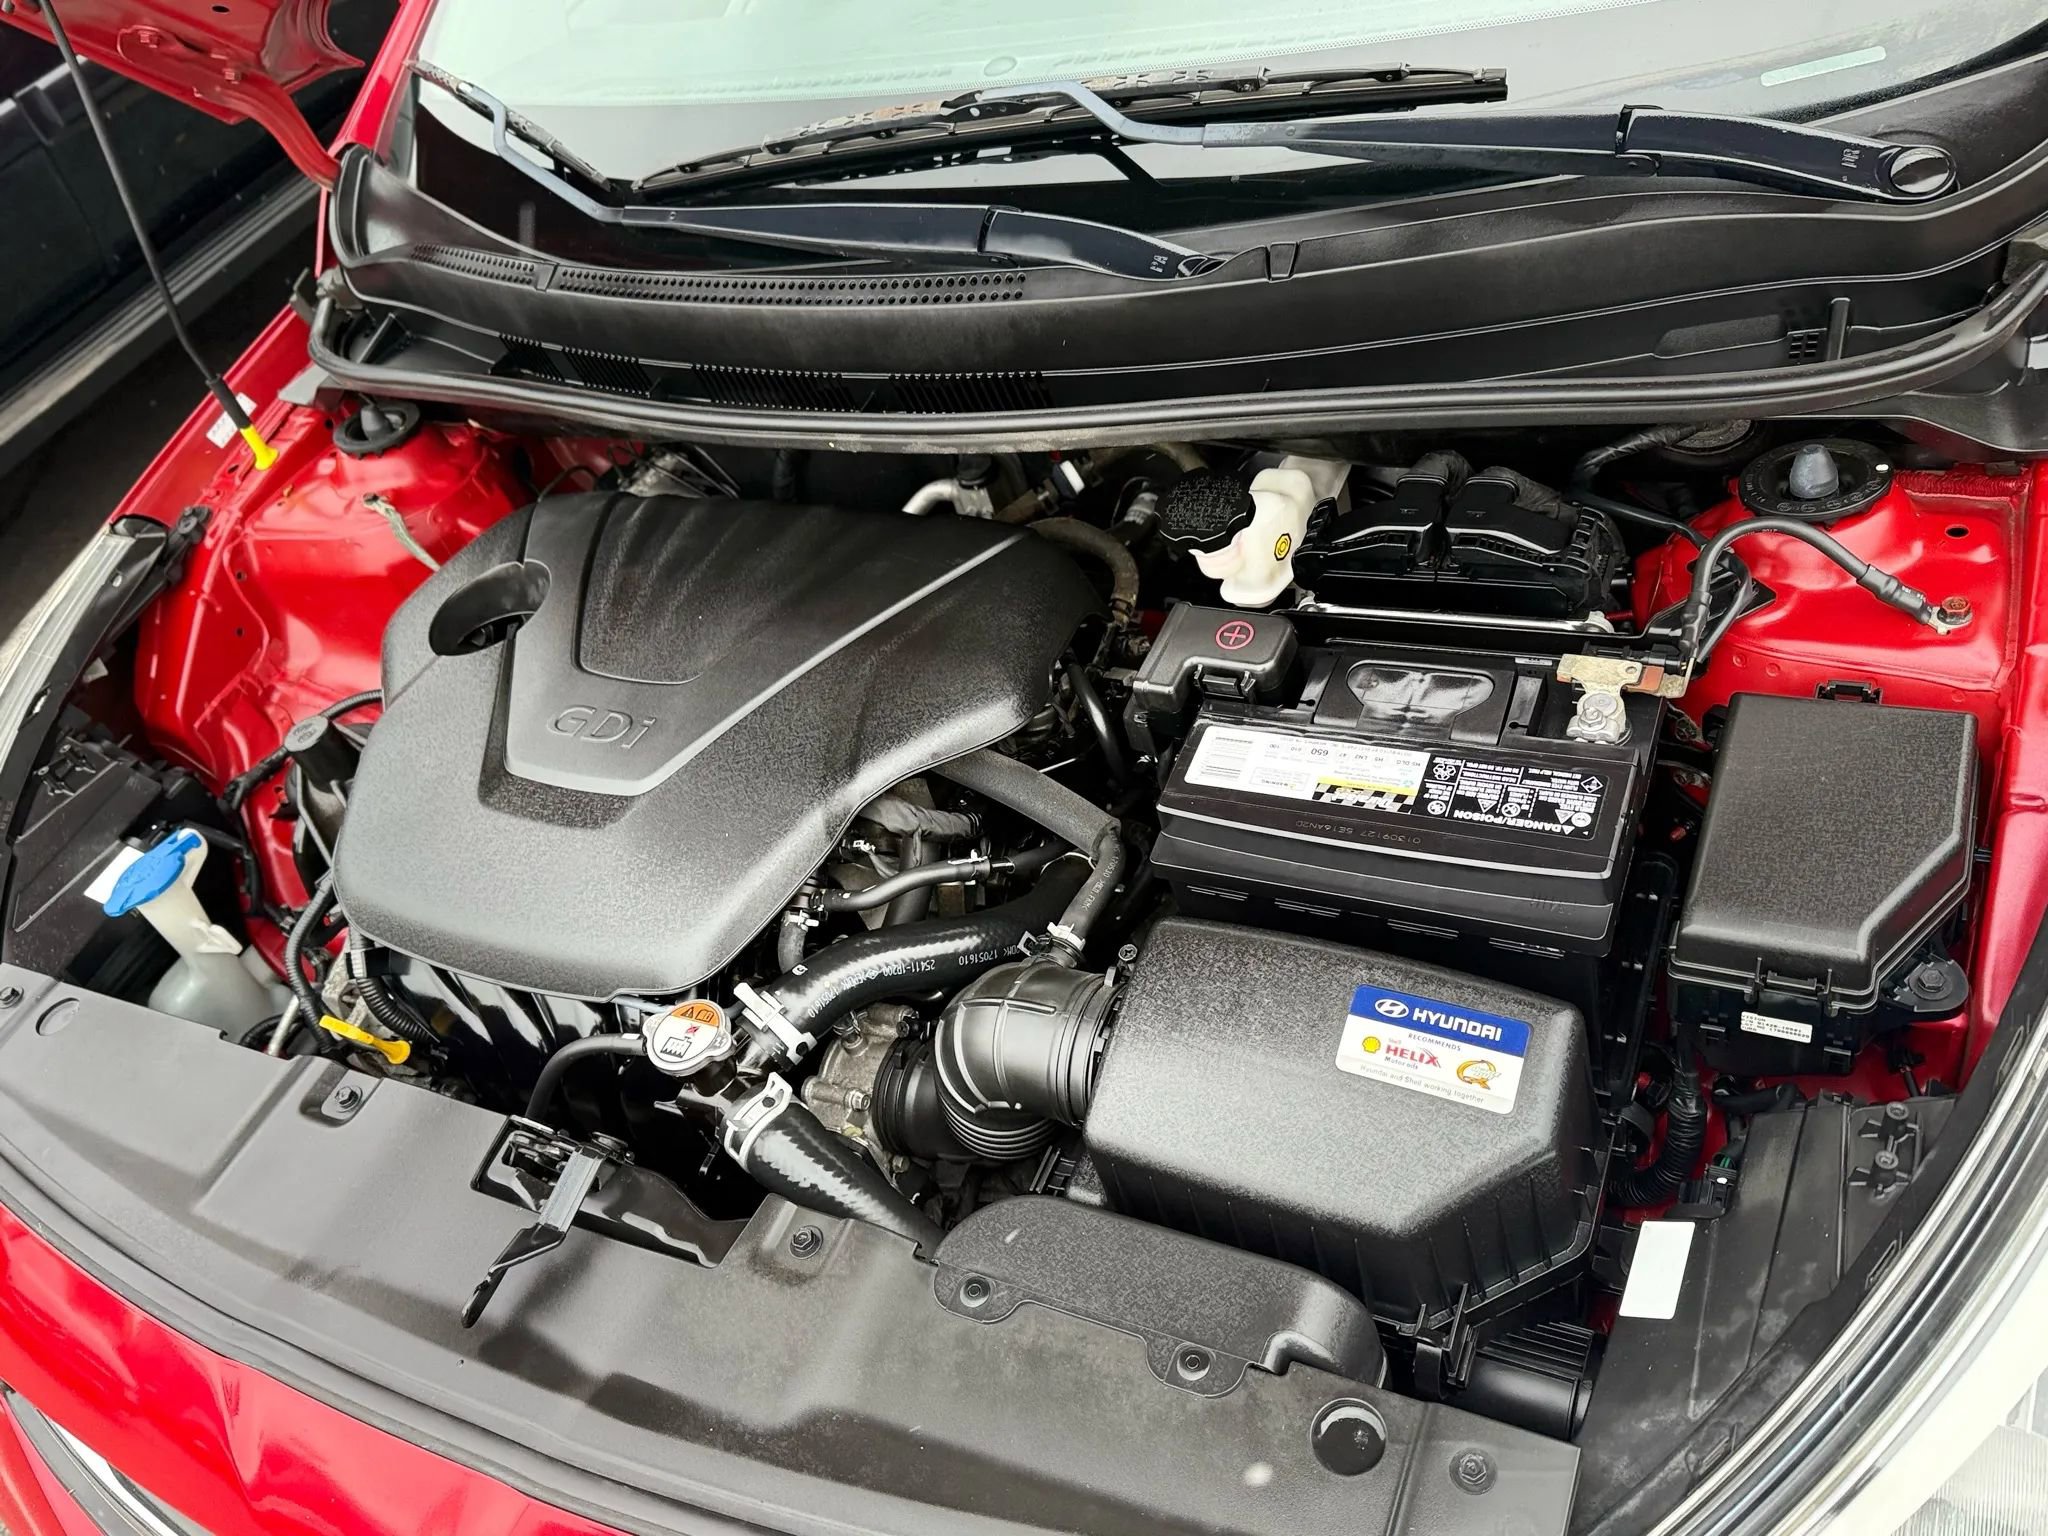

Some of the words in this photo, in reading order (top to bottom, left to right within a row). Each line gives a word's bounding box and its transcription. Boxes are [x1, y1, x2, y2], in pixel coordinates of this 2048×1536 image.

[546, 704, 657, 748] GDi
[1310, 747, 1328, 756] 650
[958, 949, 998, 966] 17051610
[1413, 1007, 1502, 1041] HYUNDAI
[1408, 1033, 1461, 1051] RECOMMENDS
[1386, 1044, 1442, 1068] HELIX
[1405, 1076, 1422, 1087] Shell
[1424, 1082, 1452, 1097] working
[1454, 1089, 1484, 1104] together
